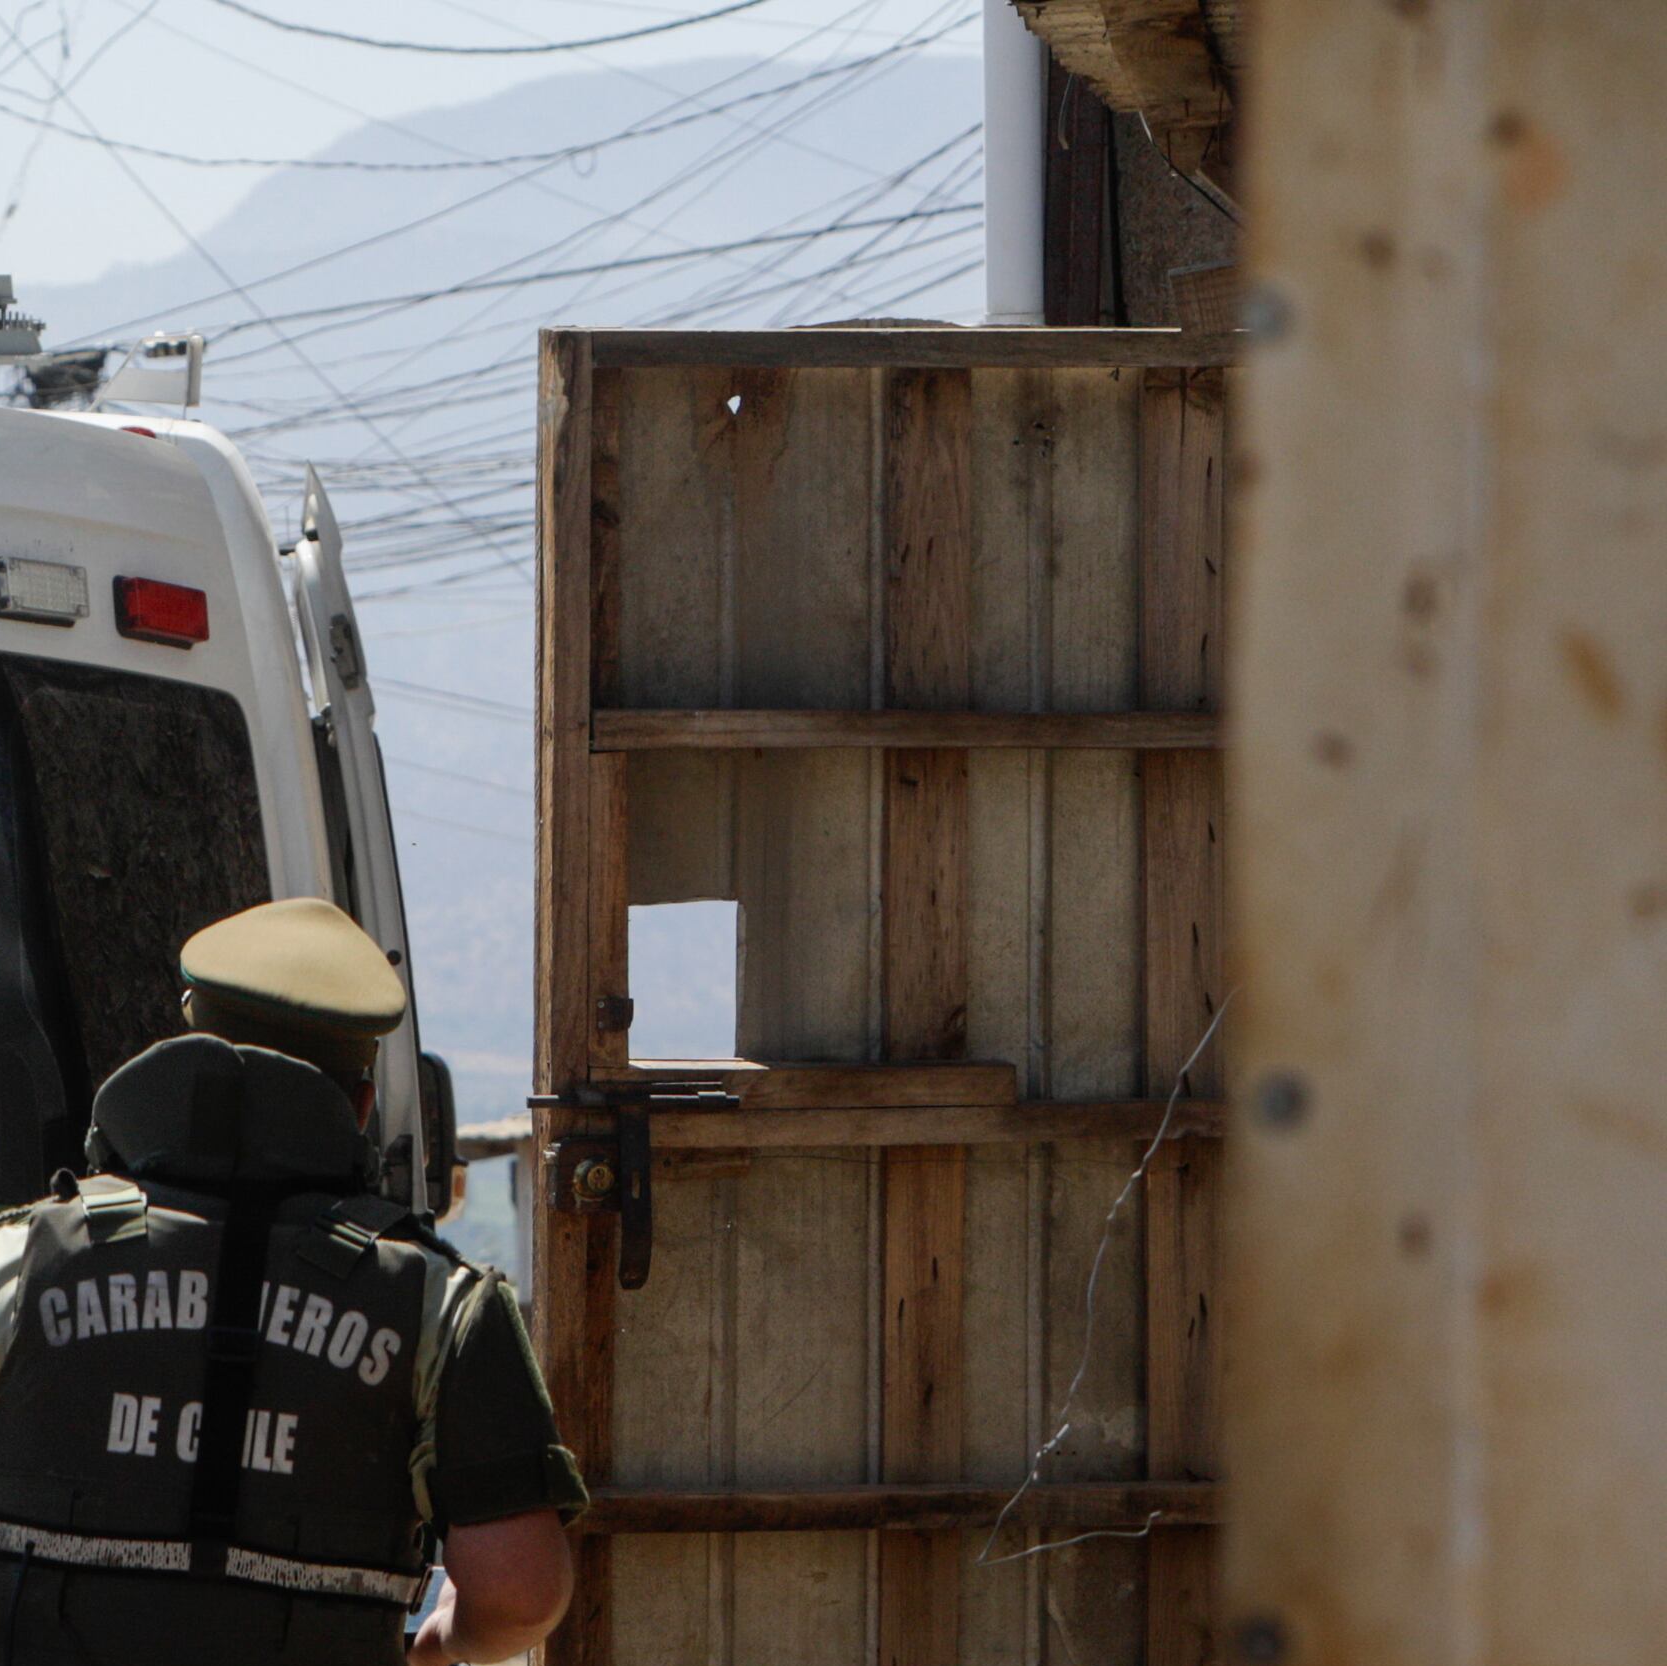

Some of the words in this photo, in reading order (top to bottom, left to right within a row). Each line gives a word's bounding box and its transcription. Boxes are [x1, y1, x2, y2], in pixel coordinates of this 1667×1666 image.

[38, 1269, 402, 1387] CARABEROS
[106, 1392, 162, 1458] DE
[176, 1401, 299, 1475] CILE
